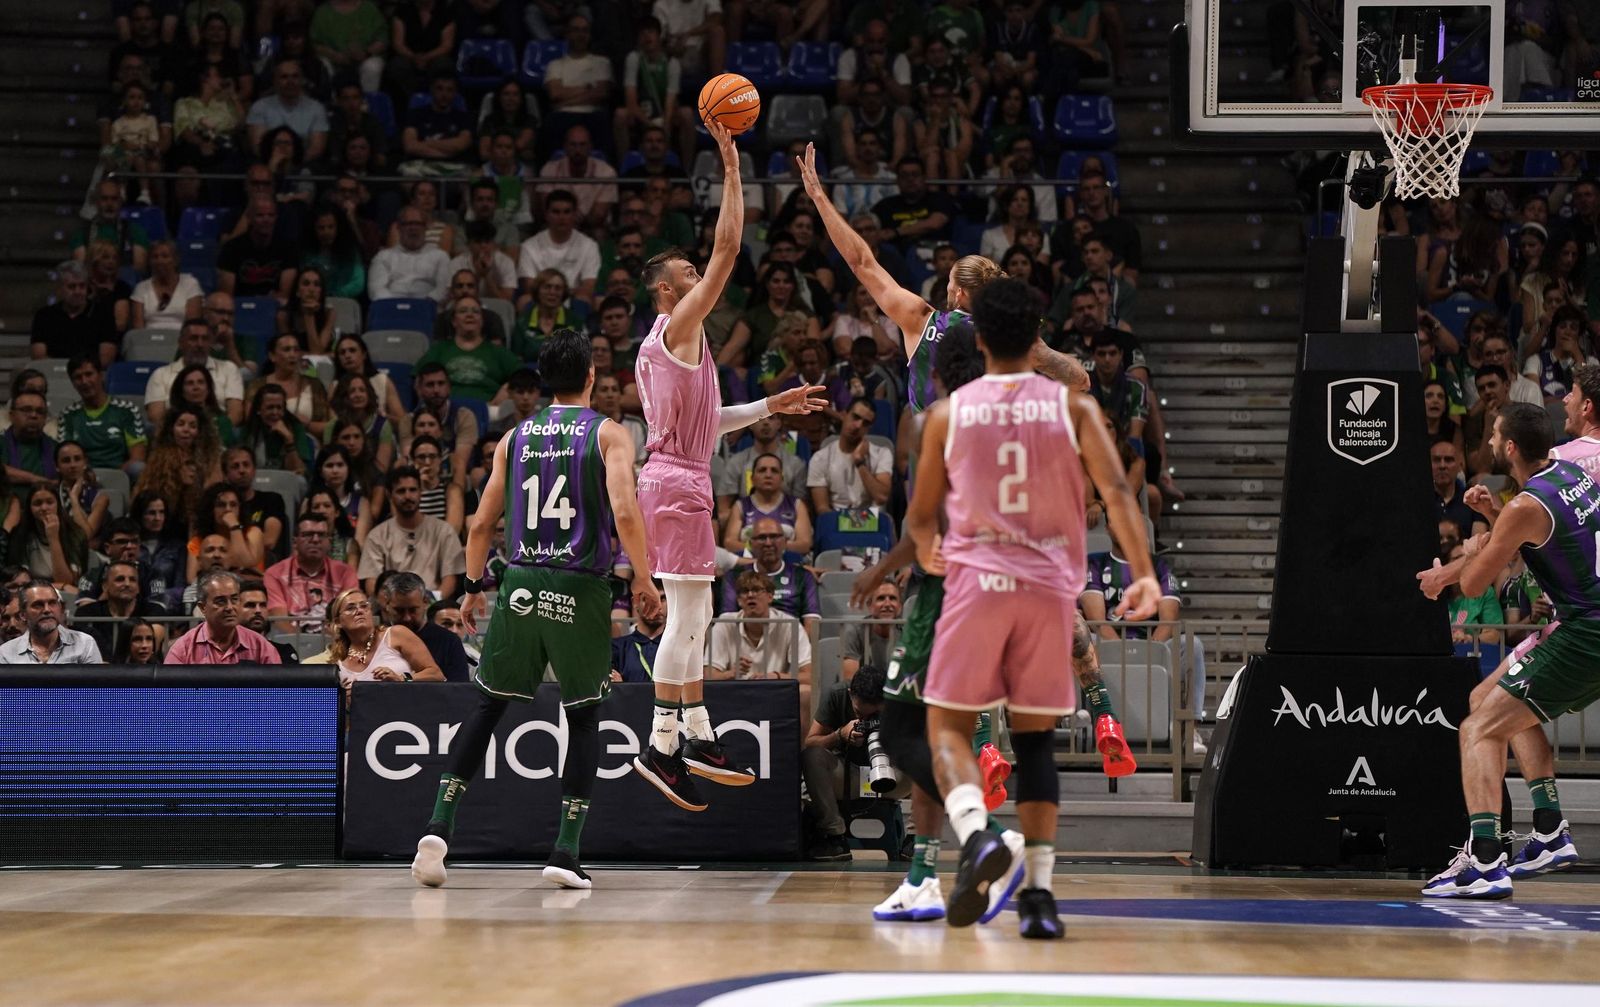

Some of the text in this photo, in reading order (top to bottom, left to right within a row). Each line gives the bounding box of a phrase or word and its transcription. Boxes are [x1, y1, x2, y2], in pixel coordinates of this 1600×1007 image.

[1577, 77, 1600, 89] liga
[960, 399, 1059, 427] DOTSON
[1340, 418, 1387, 428] Fundación
[1339, 438, 1388, 447] Baloncesto
[1346, 430, 1381, 440] Unicaja
[997, 441, 1029, 513] 2
[1558, 471, 1596, 506] Kravish
[521, 474, 577, 530] 14
[538, 590, 576, 607] COSTA
[537, 600, 575, 616] DEL SOL
[537, 609, 574, 624] MÁLAGA
[1271, 684, 1459, 731] Andalucía
[365, 701, 770, 780] endea
[1360, 787, 1397, 796] Andalucía
